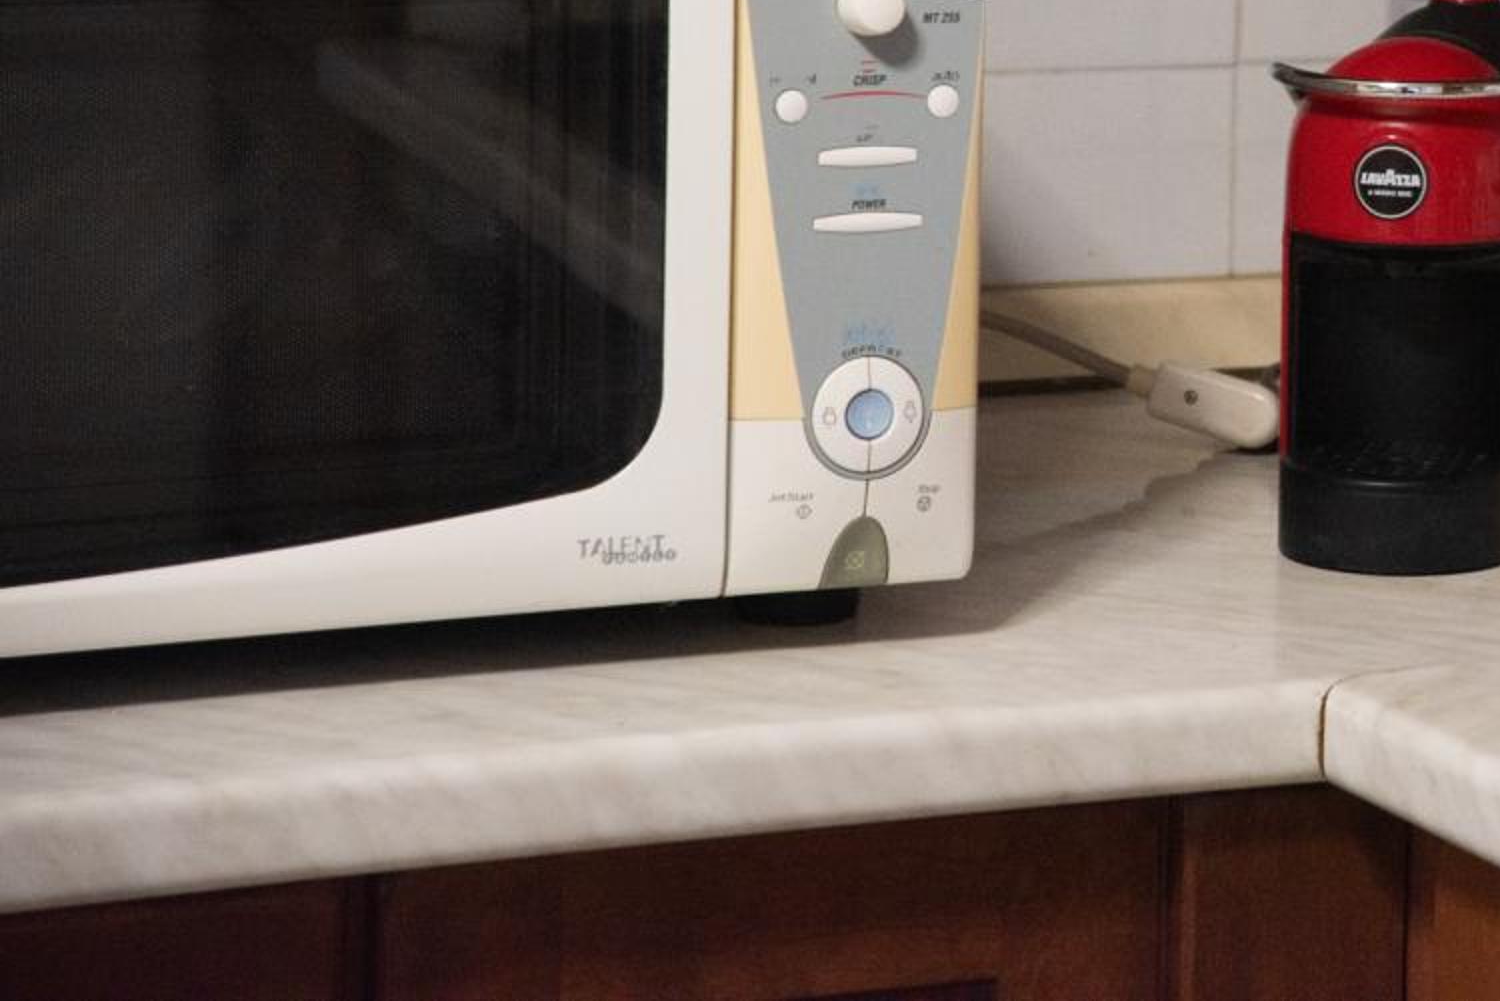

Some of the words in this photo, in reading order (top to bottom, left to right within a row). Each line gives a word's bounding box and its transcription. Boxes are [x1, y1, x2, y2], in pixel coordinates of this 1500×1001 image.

[853, 73, 888, 86] CRISP
[1359, 168, 1421, 188] LAVAZZA
[850, 198, 887, 211] POWER
[576, 534, 667, 559] TALENT
